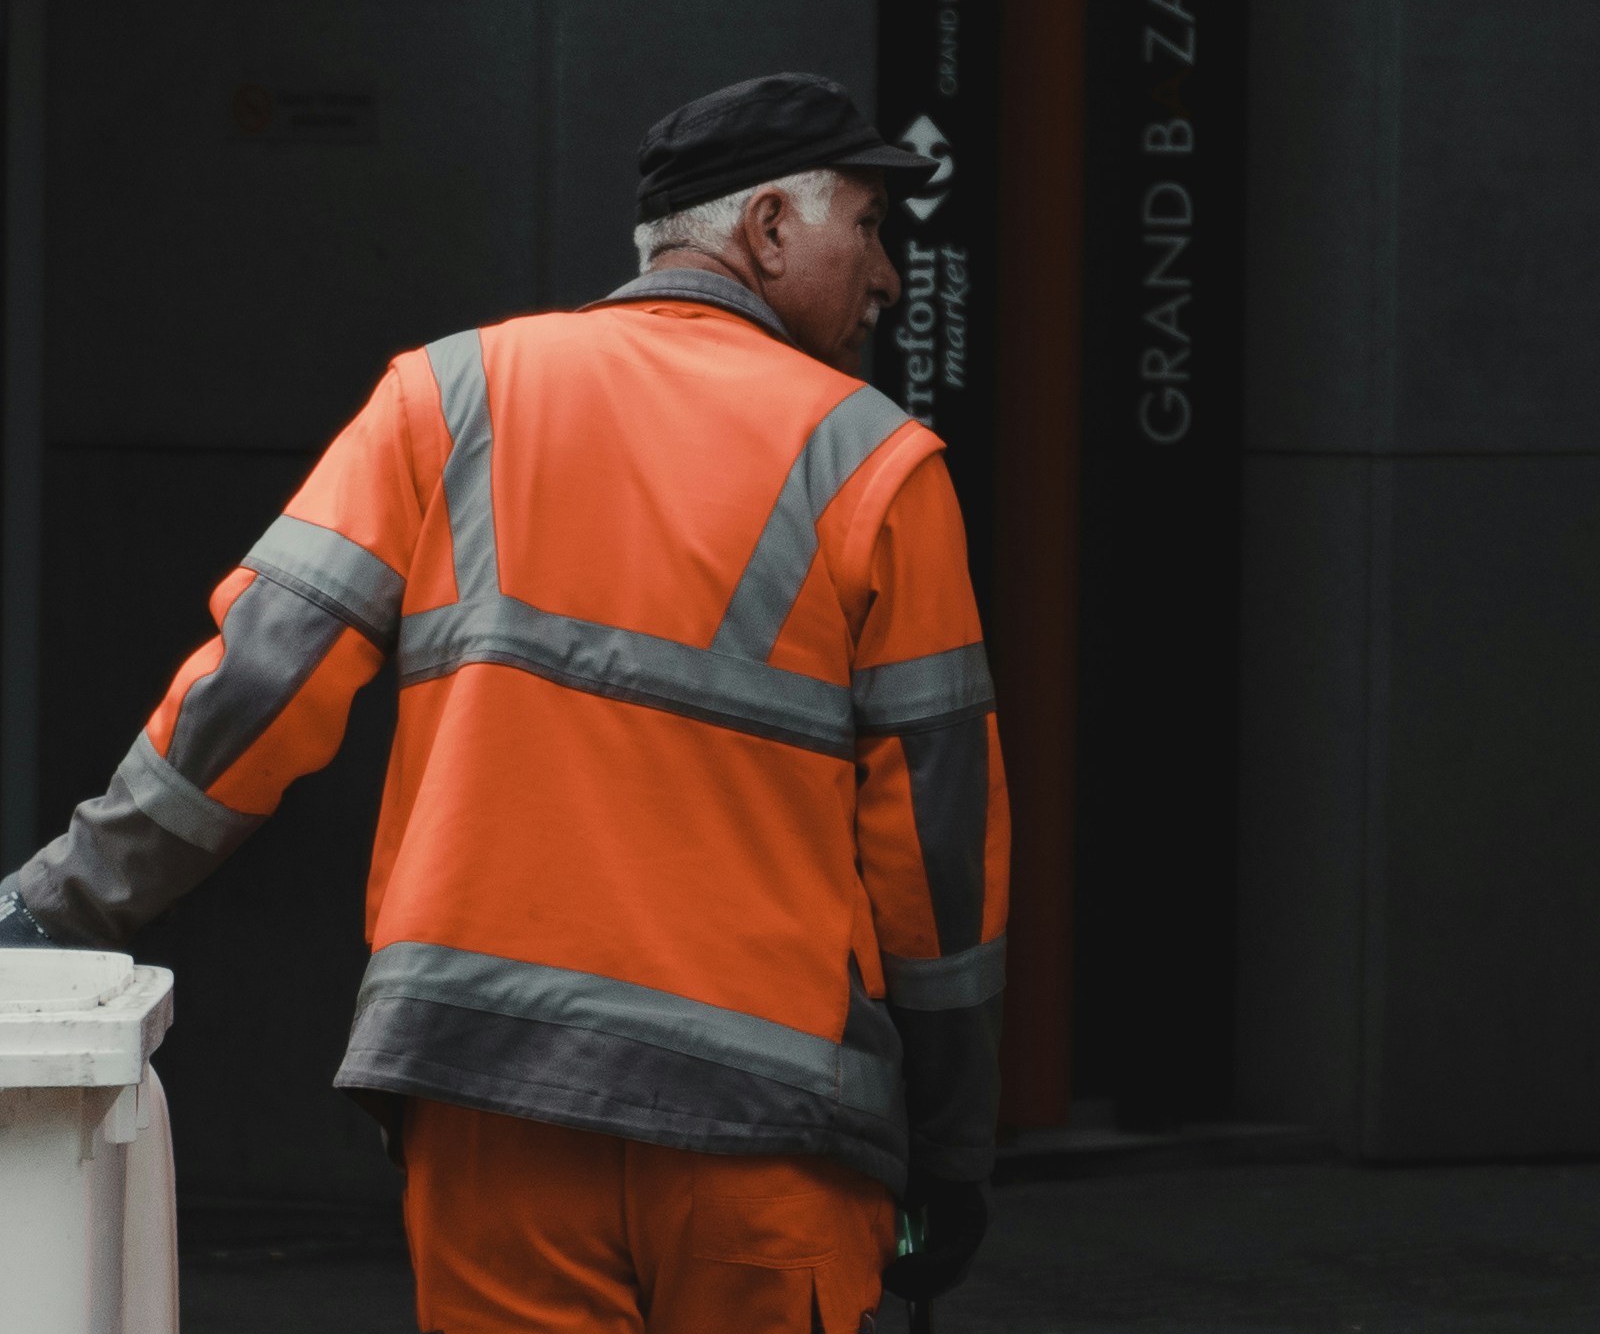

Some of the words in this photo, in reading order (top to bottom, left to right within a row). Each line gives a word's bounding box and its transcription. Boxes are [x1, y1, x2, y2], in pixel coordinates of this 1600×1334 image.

[938, 9, 960, 97] GRAND
[940, 244, 970, 389] market
[1139, 180, 1193, 444] GRAND
